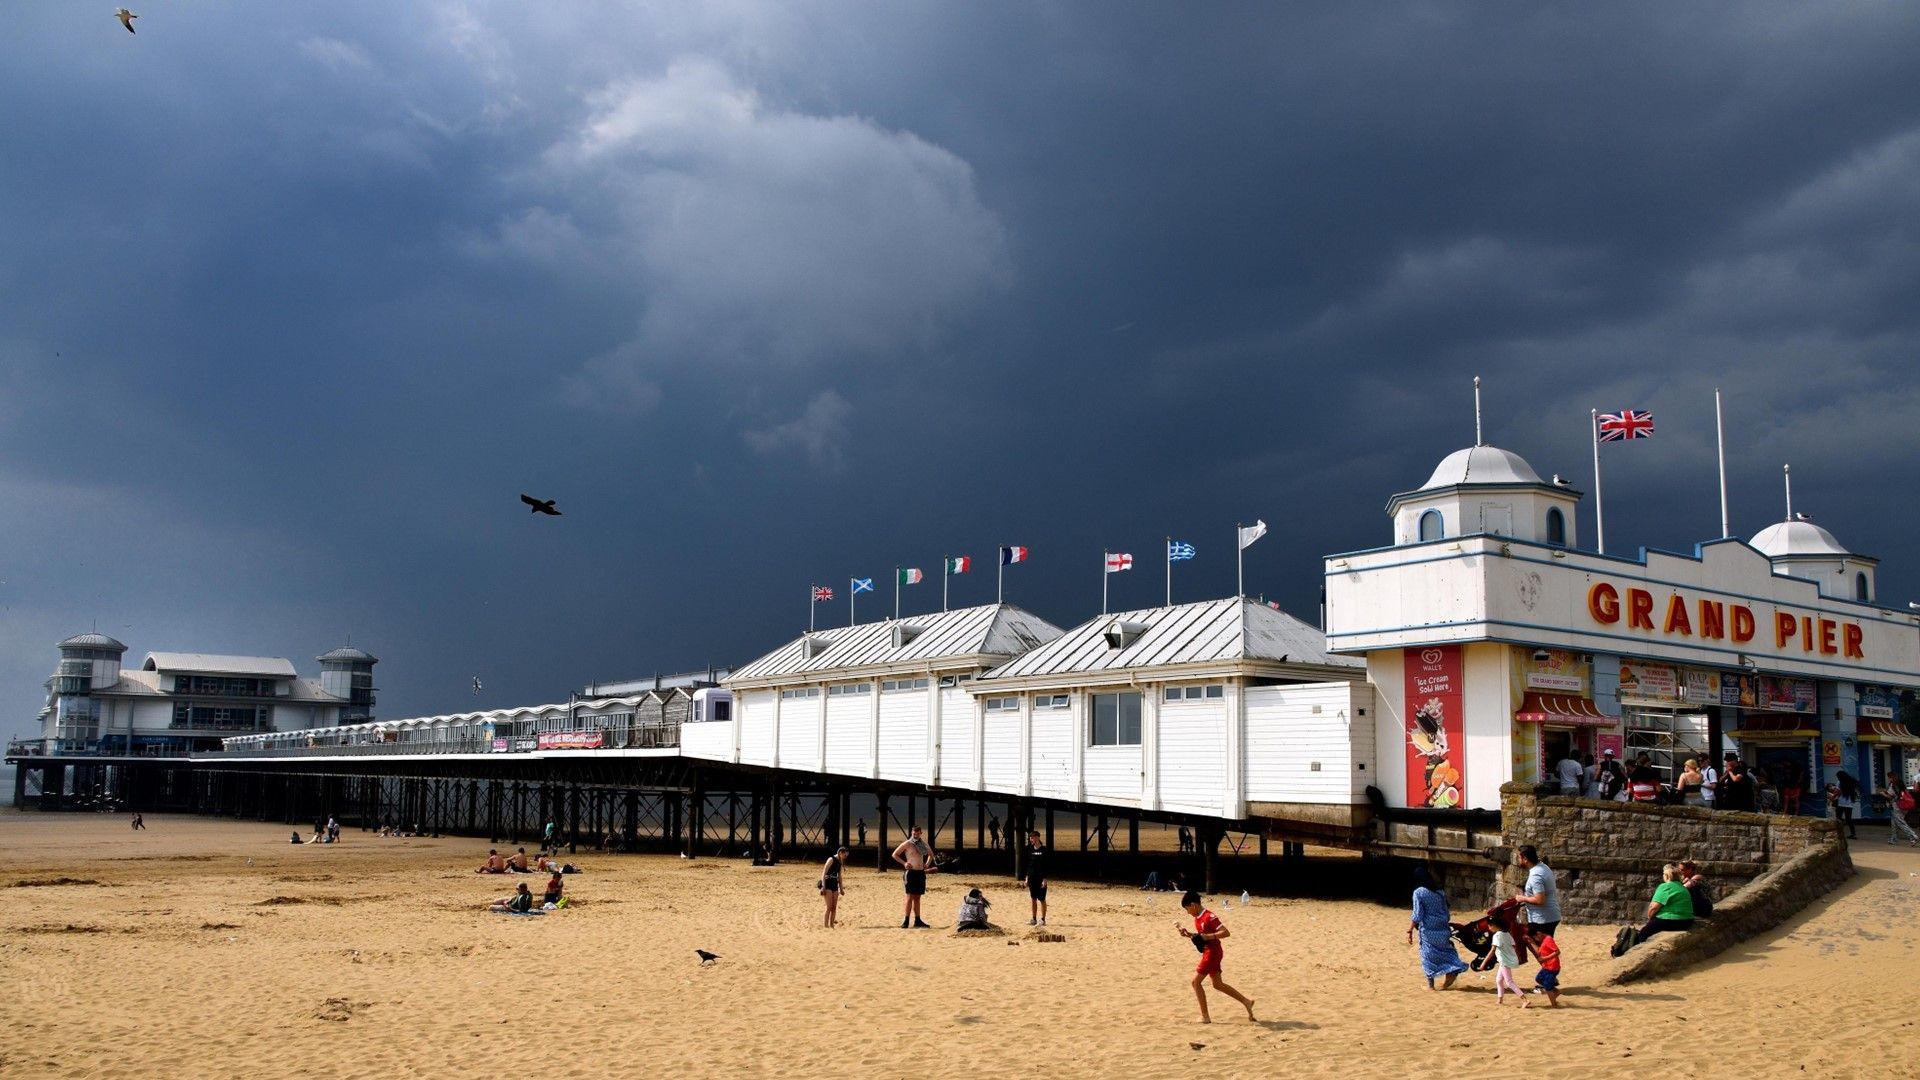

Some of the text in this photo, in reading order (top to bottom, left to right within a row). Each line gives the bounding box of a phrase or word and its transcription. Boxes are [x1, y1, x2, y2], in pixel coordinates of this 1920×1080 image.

[1588, 583, 1864, 657] GRAND PIER
[1428, 675, 1449, 684] Cream
[1419, 686, 1433, 694] Sold
